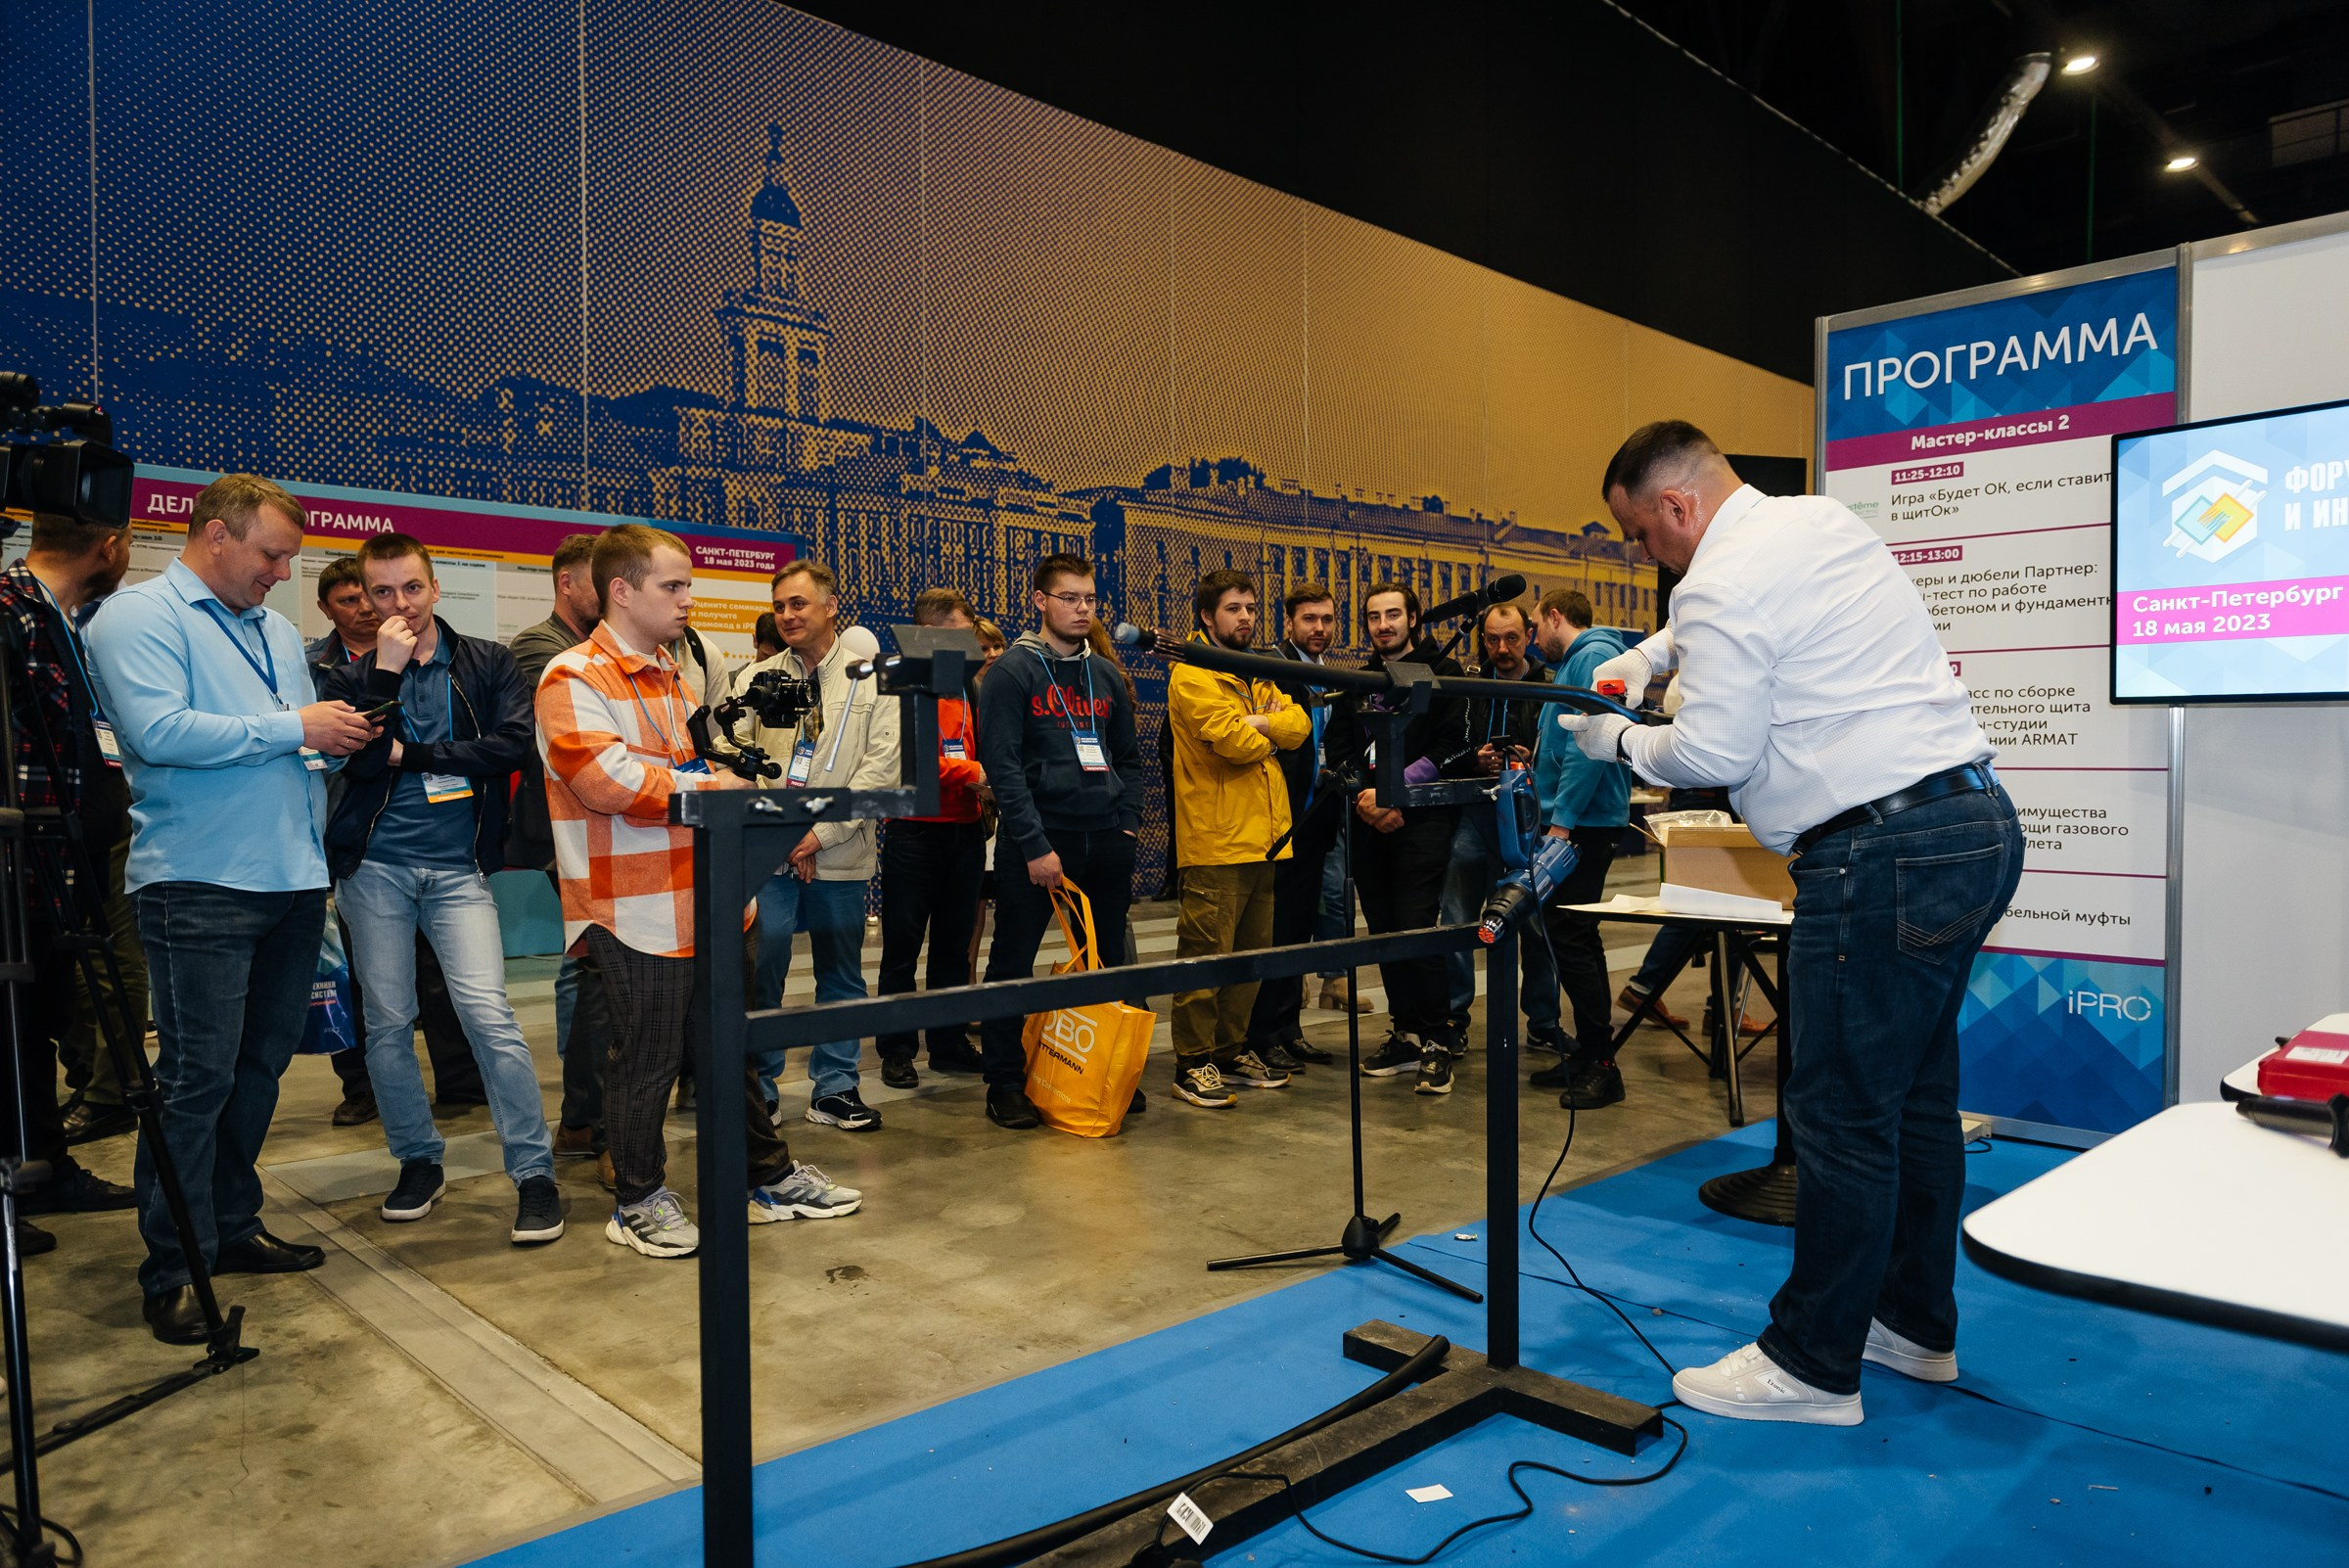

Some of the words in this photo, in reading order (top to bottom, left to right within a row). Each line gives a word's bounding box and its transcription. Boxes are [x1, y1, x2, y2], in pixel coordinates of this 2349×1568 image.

[1844, 313, 2158, 400] ПРОГРАММА
[1911, 420, 2053, 450] Мастер-классы
[2057, 414, 2070, 431] 2
[1895, 465, 1960, 483] 11:25-12:10
[1891, 493, 1925, 507] Игра
[1929, 486, 1980, 504] «Будет
[2015, 477, 2053, 493] если
[2057, 471, 2111, 487] ставит
[147, 493, 194, 515] ДЕЛ
[304, 509, 394, 533] ГРАММА
[1903, 505, 1959, 521] щитОк»
[2284, 501, 2301, 531] И
[2313, 496, 2349, 529] ИН
[696, 545, 775, 561] САНКТ-ПЕТЕРБУРГ
[1894, 549, 1959, 563] 12:15-13:00
[734, 559, 755, 568] 2023
[757, 562, 775, 571] года
[1960, 569, 2020, 585] дюбели
[2025, 562, 2097, 578] Партнер:
[1968, 588, 1987, 599] по
[1992, 582, 2047, 599] работе
[2133, 584, 2343, 614] Санкт-Петербург
[729, 603, 770, 613] семинары
[2002, 603, 2010, 612] и
[699, 612, 737, 622] получите
[2133, 620, 2158, 637] 18
[2164, 619, 2206, 636] мая
[2213, 613, 2272, 633] 2023
[743, 623, 757, 631] iPR
[1032, 684, 1109, 718] s.Oliver
[1995, 689, 2013, 698] по
[2018, 686, 2076, 700] сборке
[2050, 703, 2091, 715] щита
[2021, 732, 2078, 746] ARMAT
[2056, 824, 2129, 837] газового
[2004, 905, 2070, 921] бельной
[2075, 910, 2131, 927] муфты
[2068, 990, 2151, 1022] iPRO
